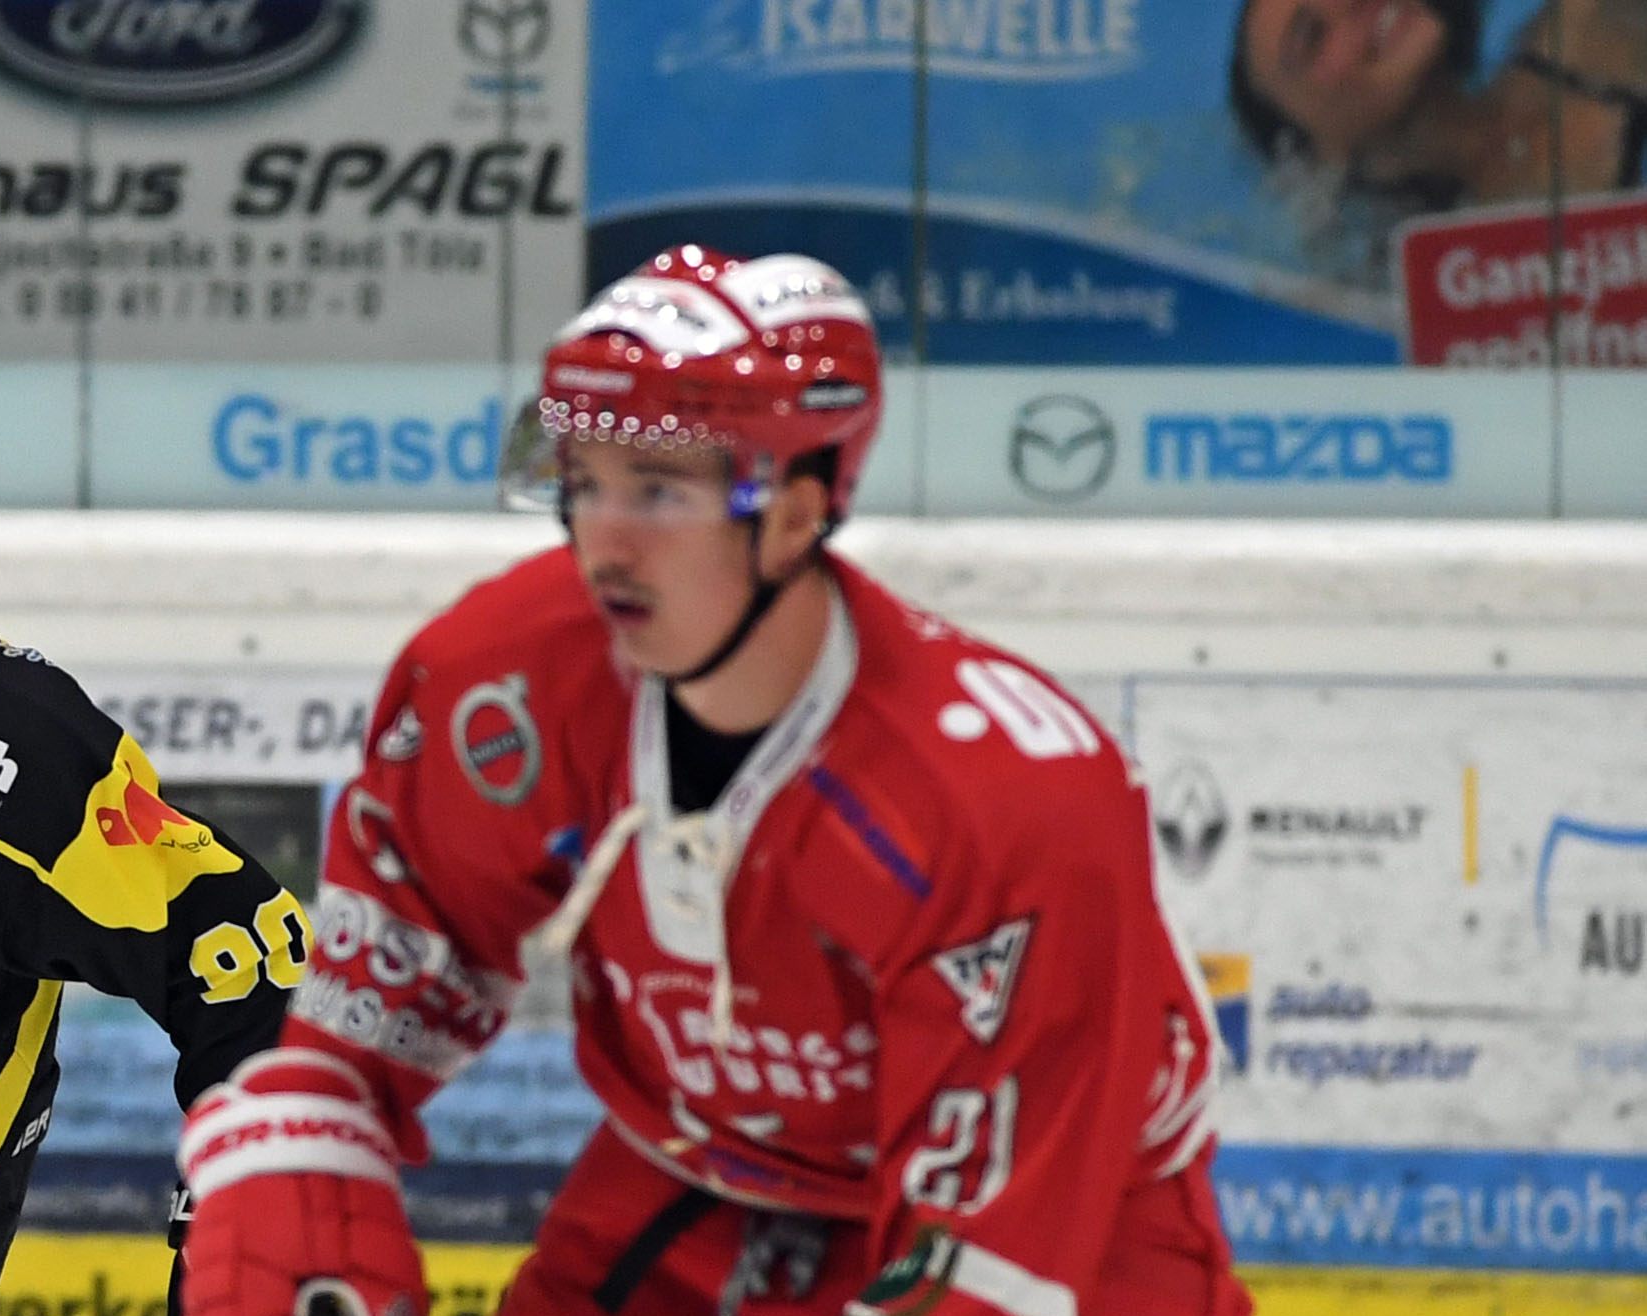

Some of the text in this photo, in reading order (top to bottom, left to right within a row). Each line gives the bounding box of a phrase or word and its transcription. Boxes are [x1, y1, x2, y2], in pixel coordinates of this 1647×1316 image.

[229, 141, 575, 218] SPAGL
[962, 270, 1176, 336] Erholung
[1144, 414, 1454, 483] mazda
[1267, 979, 1373, 1023] auto
